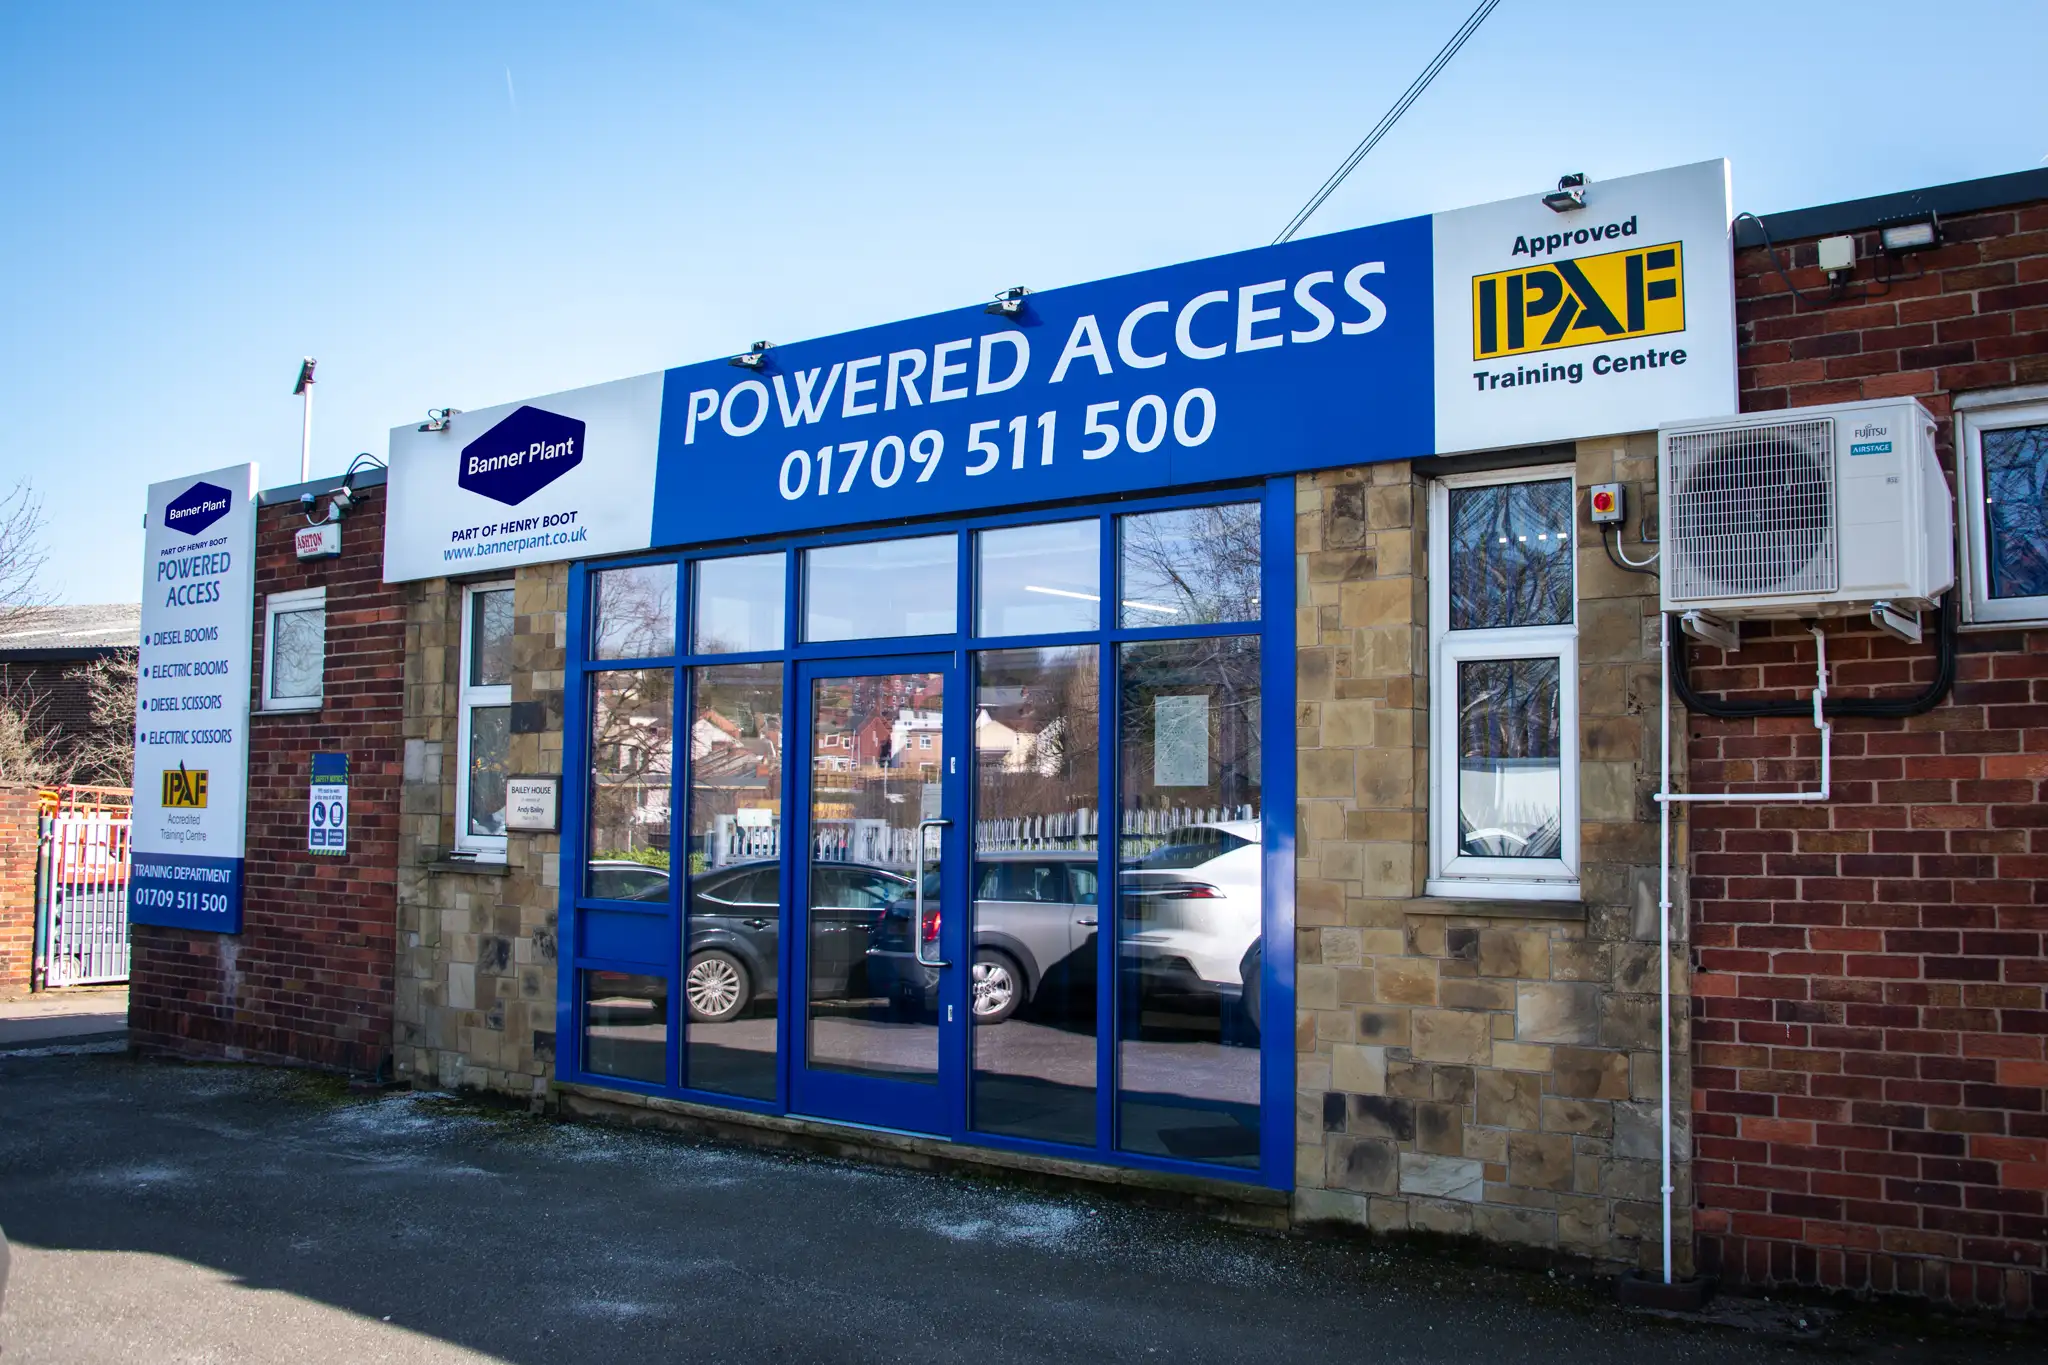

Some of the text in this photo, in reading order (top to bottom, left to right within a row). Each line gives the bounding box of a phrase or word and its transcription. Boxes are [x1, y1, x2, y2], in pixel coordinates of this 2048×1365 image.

[1511, 215, 1638, 257] Approved
[1479, 248, 1677, 354] IPAF
[684, 261, 1387, 445] POWERED ACCESS
[1473, 348, 1687, 391] Training Centre
[1854, 424, 1887, 439] FUJITSU
[778, 387, 1217, 501] 01709 511 500
[1852, 444, 1890, 454] AIRSTAGE
[468, 437, 574, 475] Banner Plant
[169, 498, 226, 520] Banner Plant
[451, 511, 578, 542] PART OF HENRY BOOT
[161, 537, 228, 556] PART OF HENRY BOOT
[297, 532, 323, 550] ASHTON
[443, 525, 588, 561] www.bannerplant.co.uk
[157, 551, 231, 582] POWERED
[166, 581, 220, 607] ACCESS
[153, 626, 219, 646] DIESEL BOOMS
[152, 660, 229, 679] ELECTRIC BOOMS
[150, 695, 222, 712] DIESEL SCISSORS
[149, 729, 232, 745] ELECTRIC SCISSORS
[163, 759, 207, 806] IPAF
[511, 786, 552, 795] BAILEY HOUSE
[168, 813, 201, 826] Accredited
[517, 806, 529, 814] Andy
[160, 828, 207, 843] Training Centre
[135, 864, 231, 883] TRAINING DEPARTMENT
[135, 887, 228, 913] 01709 511 500
